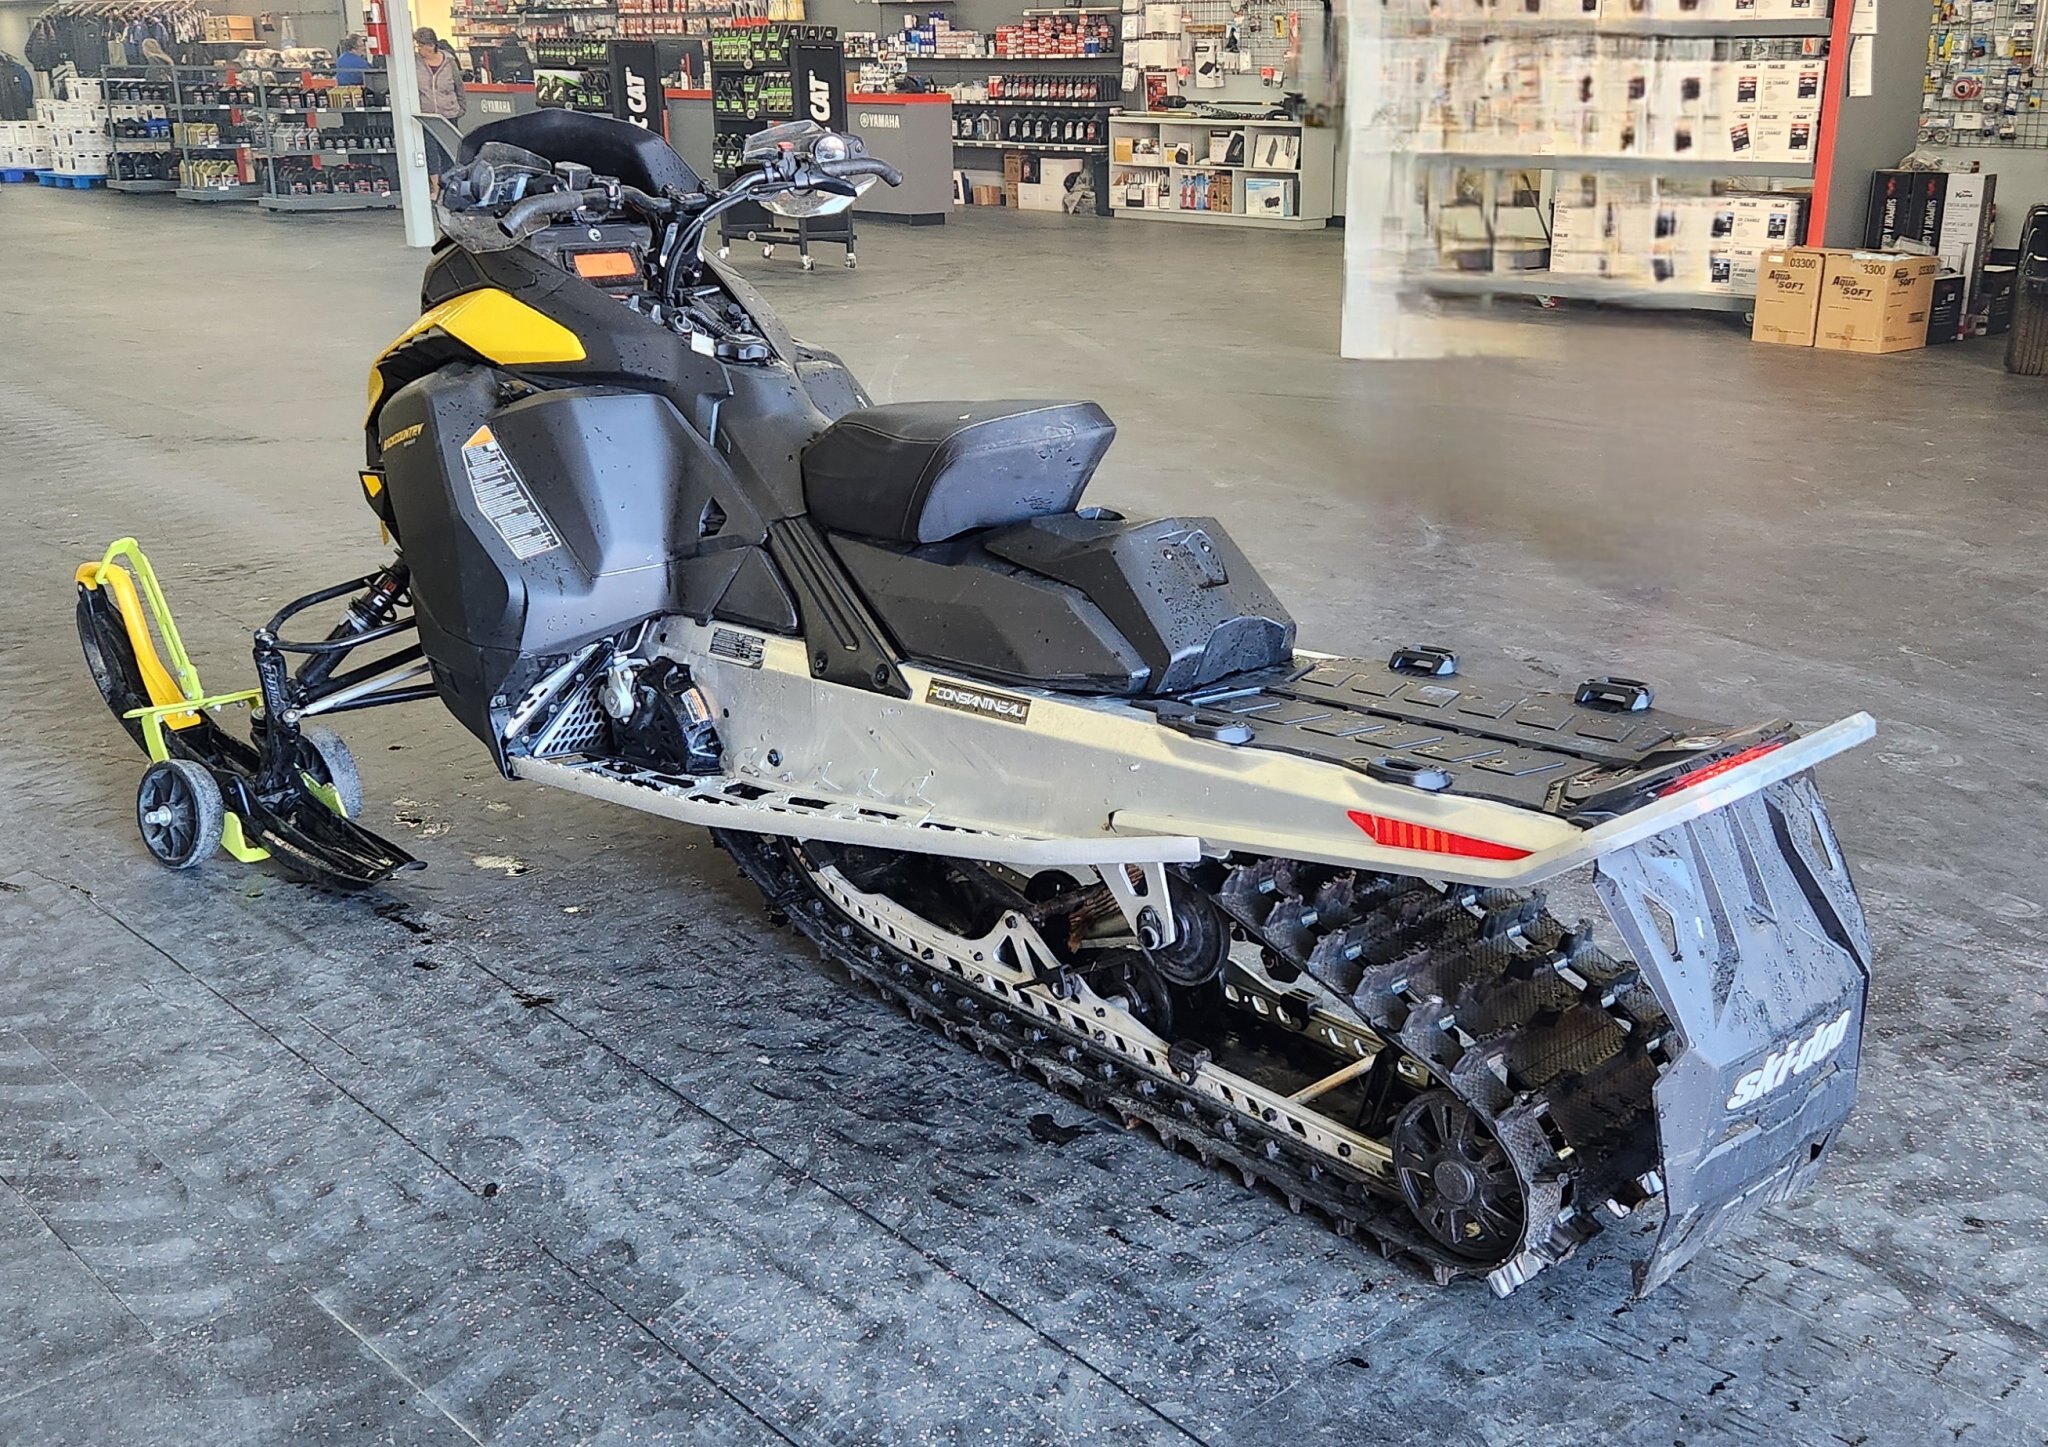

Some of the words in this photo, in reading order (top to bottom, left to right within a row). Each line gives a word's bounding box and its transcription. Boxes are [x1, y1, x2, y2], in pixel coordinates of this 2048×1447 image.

[869, 113, 901, 129] YAMAHA
[1883, 198, 1897, 227] SUPPORT
[1922, 200, 1937, 228] SUPPORT
[1790, 258, 1817, 269] 03300
[1861, 263, 1886, 275] 3300
[1777, 280, 1805, 290] SOFT
[1842, 287, 1873, 297] SOFT
[1725, 1009, 1852, 1111] ski-doo
